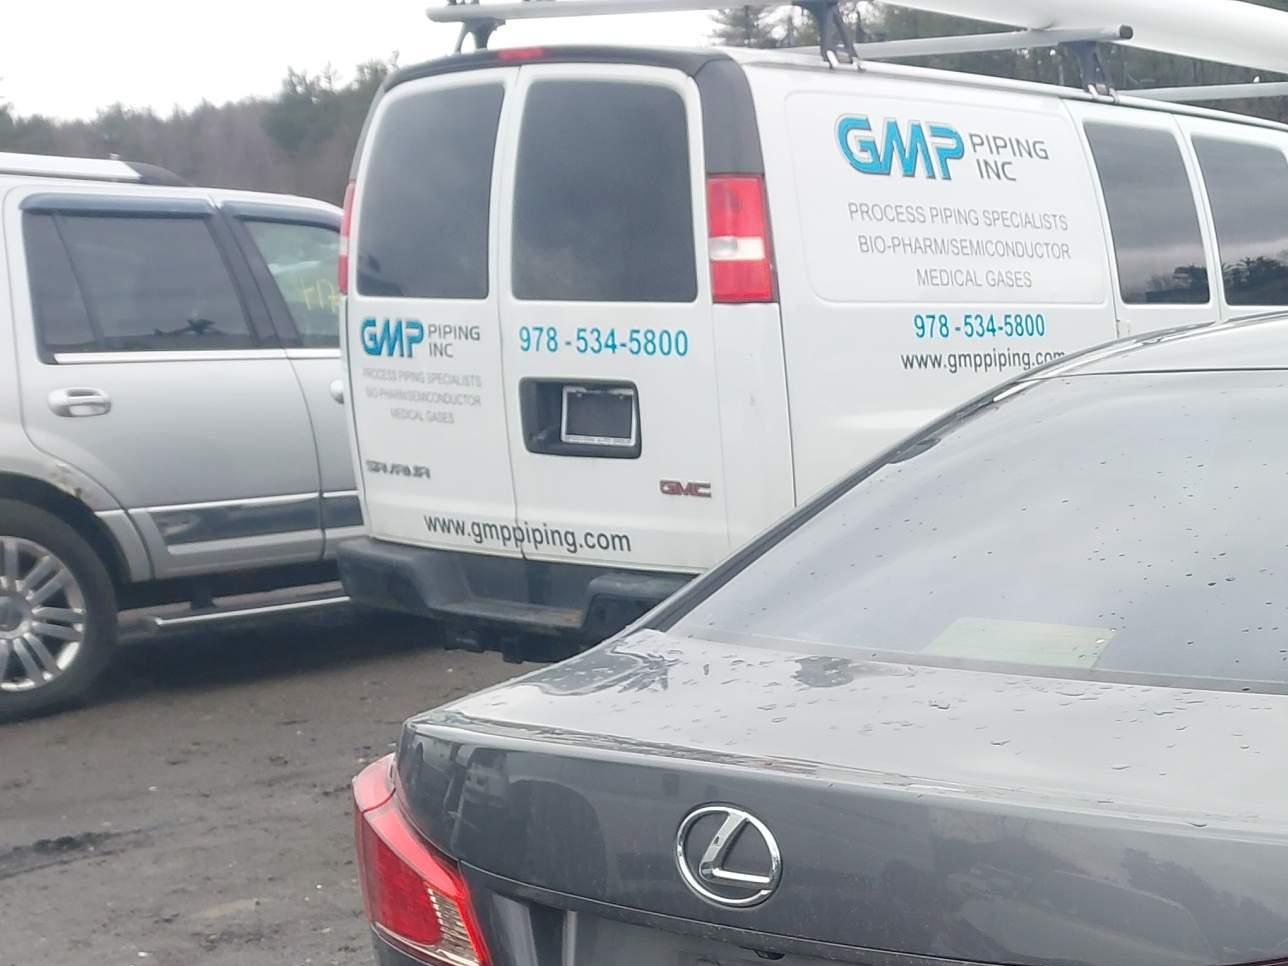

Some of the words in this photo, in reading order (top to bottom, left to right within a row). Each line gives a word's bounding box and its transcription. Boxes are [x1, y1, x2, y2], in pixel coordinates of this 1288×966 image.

[834, 113, 965, 180] GMP
[968, 133, 1049, 160] PIPING
[976, 161, 1016, 181] INC
[848, 202, 926, 224] PROCESS
[929, 207, 979, 226] PIPING
[982, 210, 1068, 231] SPECIALISTS
[916, 268, 982, 287] MEDICAL
[985, 270, 1032, 288] GASES
[360, 316, 424, 358] GMP
[428, 324, 480, 341] PIPING
[429, 343, 454, 358] INC
[660, 480, 712, 498] GMC
[424, 514, 632, 553] www.gmppiping.com
